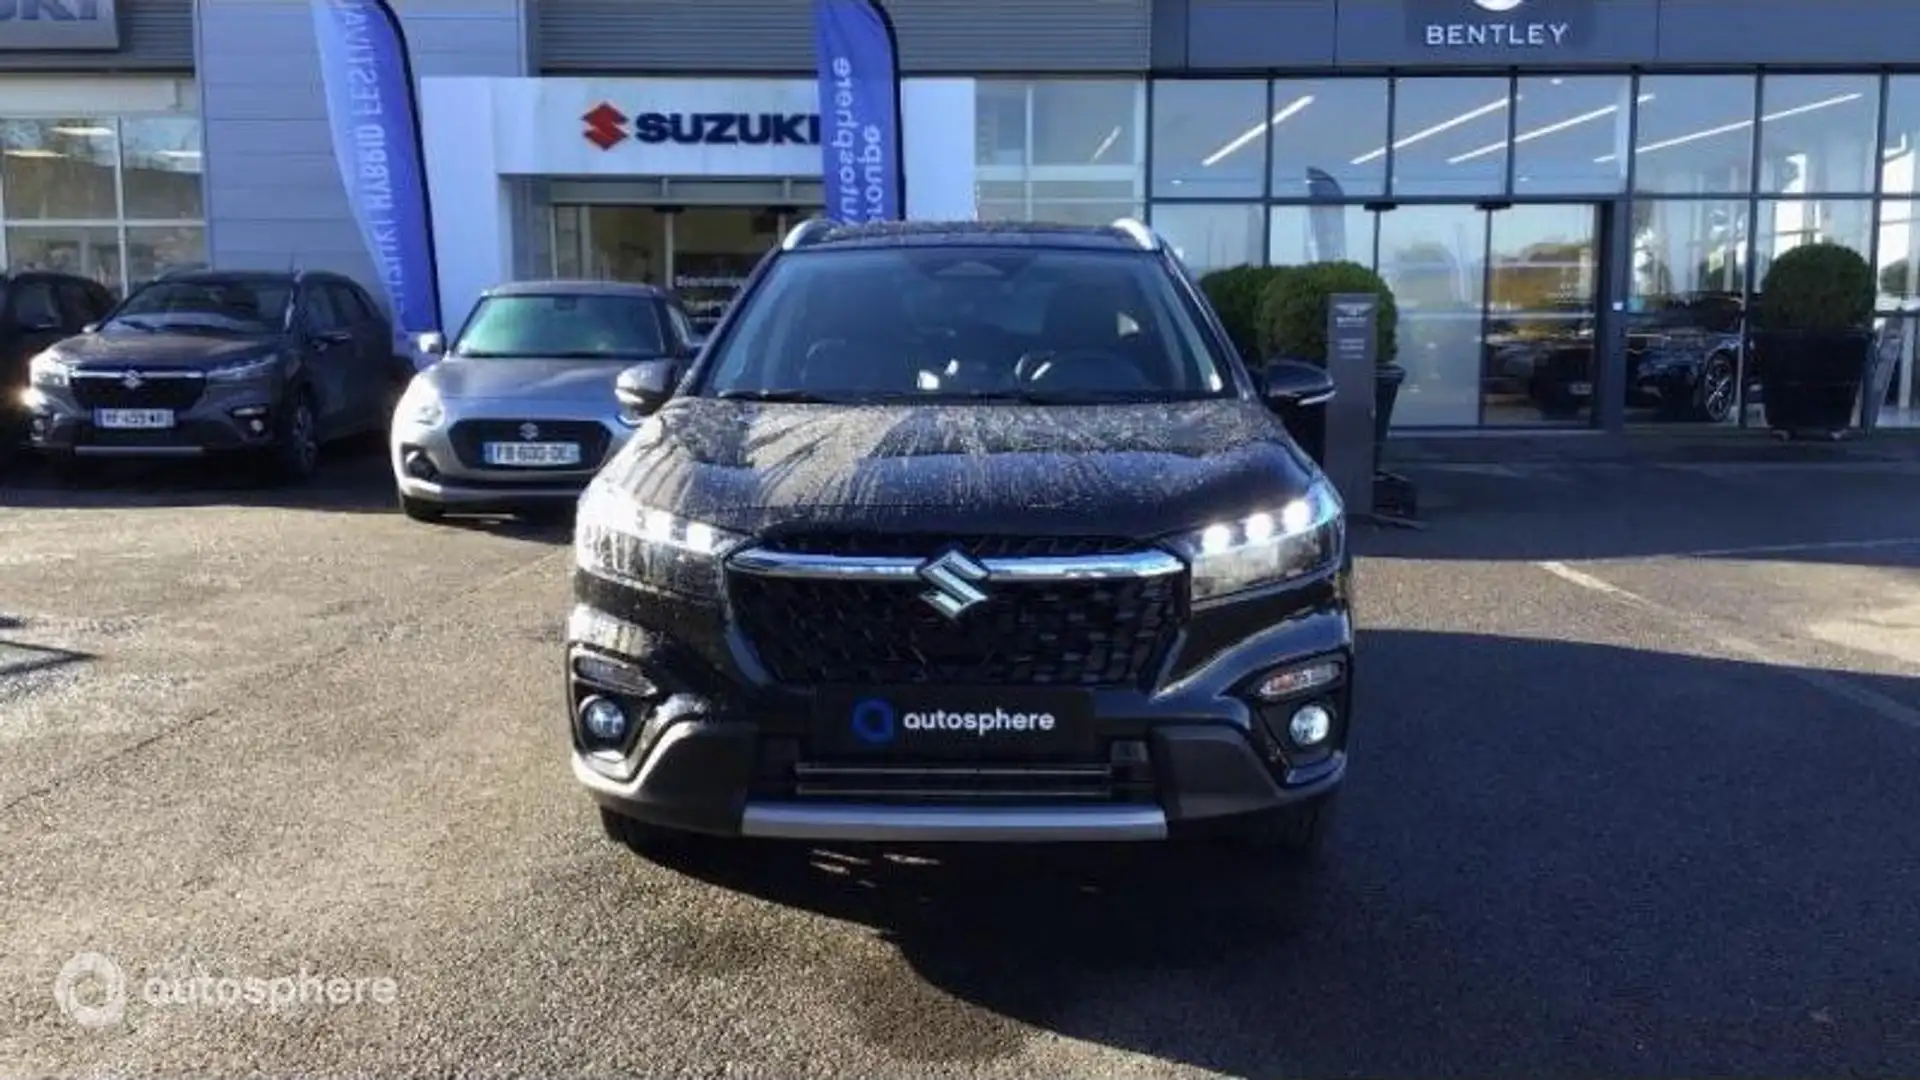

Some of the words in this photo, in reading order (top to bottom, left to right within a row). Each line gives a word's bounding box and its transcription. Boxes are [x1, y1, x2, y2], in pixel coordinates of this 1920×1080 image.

[1426, 23, 1567, 45] BENTLEY
[635, 113, 821, 145] SUZUKI
[903, 708, 1055, 736] autosphere
